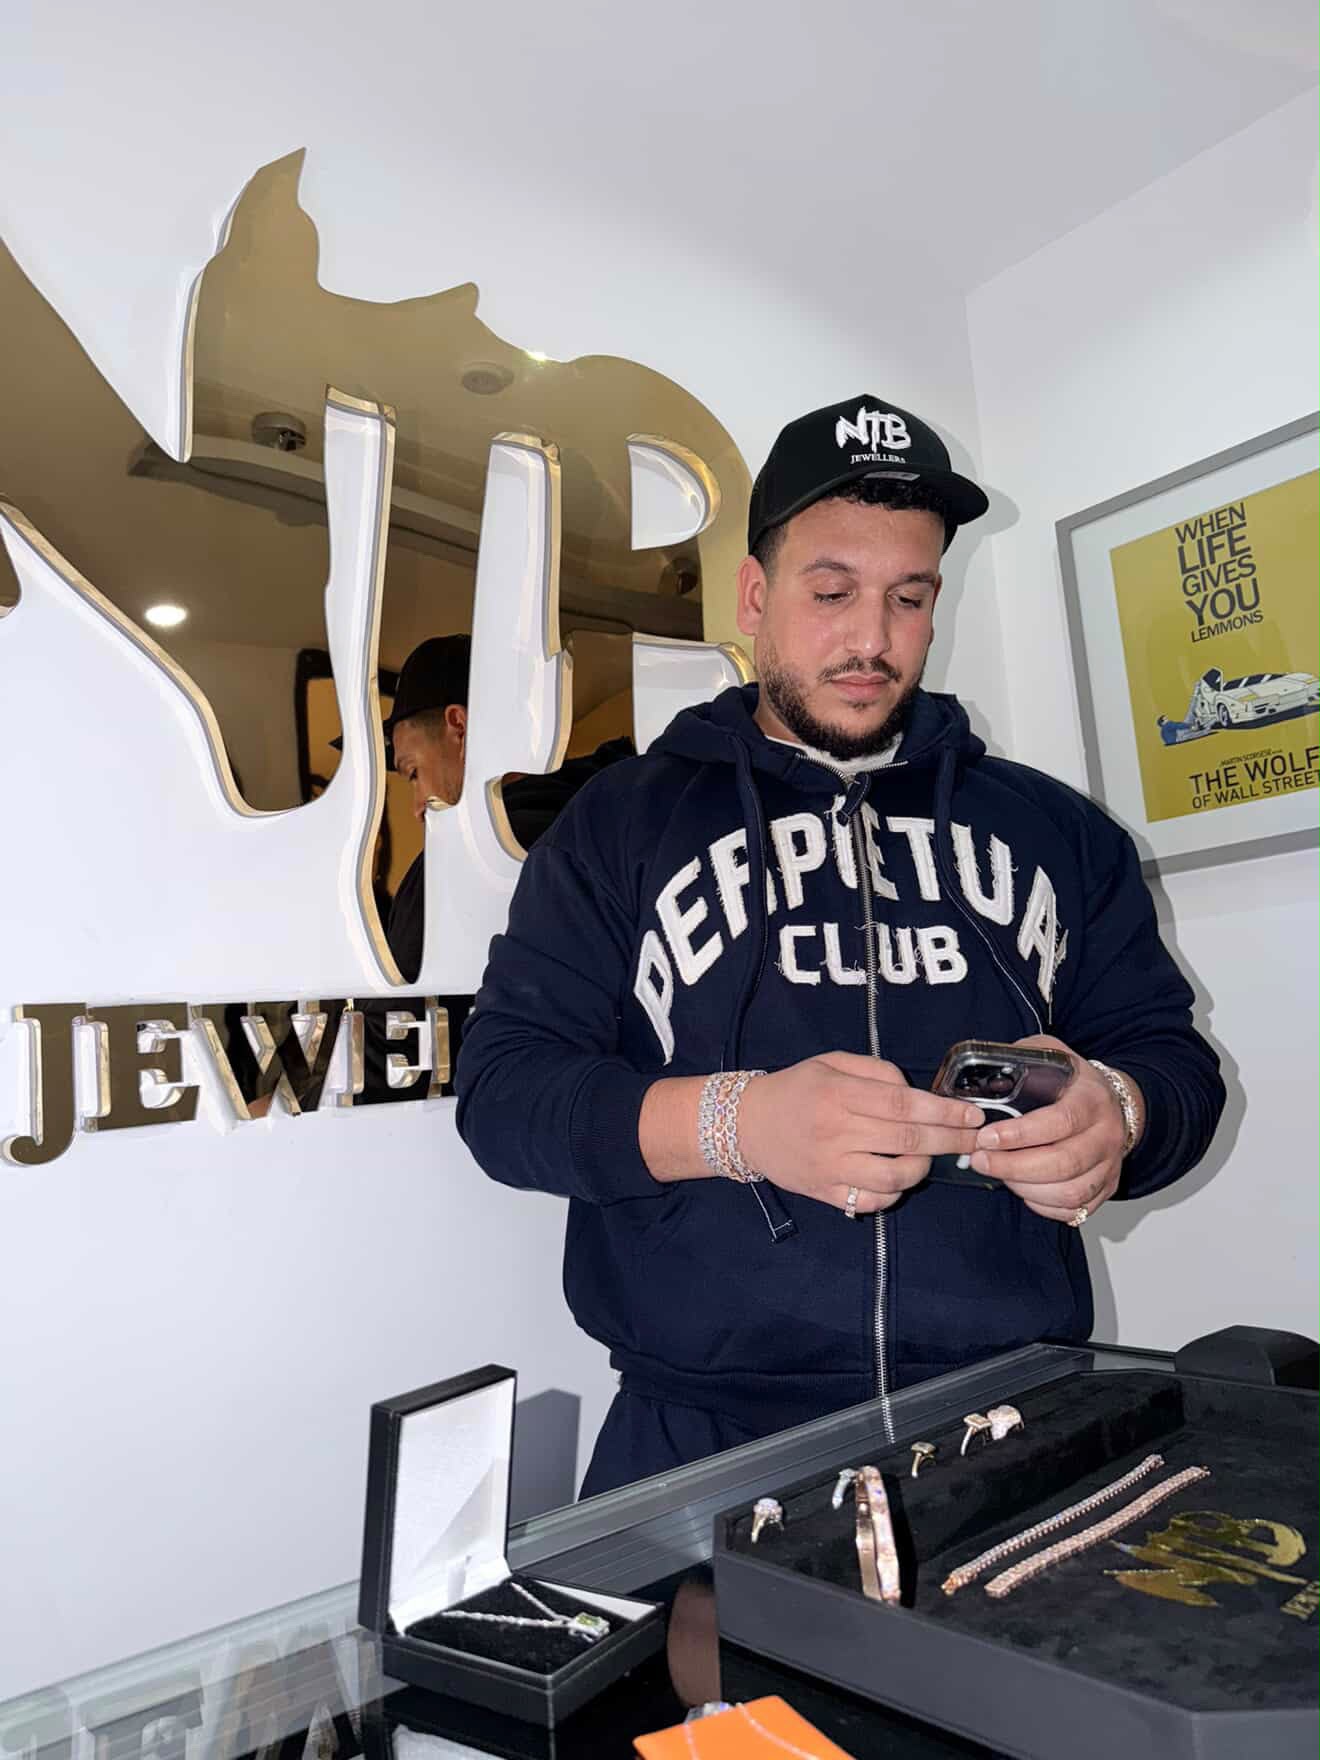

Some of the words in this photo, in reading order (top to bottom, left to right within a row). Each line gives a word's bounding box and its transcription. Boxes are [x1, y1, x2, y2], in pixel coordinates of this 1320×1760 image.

[835, 405, 912, 453] NTB
[850, 453, 906, 464] JEWELLERS
[1175, 502, 1246, 544] WHEN
[1178, 522, 1251, 576] LIFE
[1182, 554, 1257, 597] GIVES
[1185, 577, 1260, 626] YOU
[1191, 610, 1264, 643] LEMMONS
[1189, 766, 1240, 795] THE
[1243, 745, 1320, 783] WOLF
[1192, 794, 1211, 809] OF
[1214, 783, 1259, 804] WALL
[779, 922, 968, 985] CLUB
